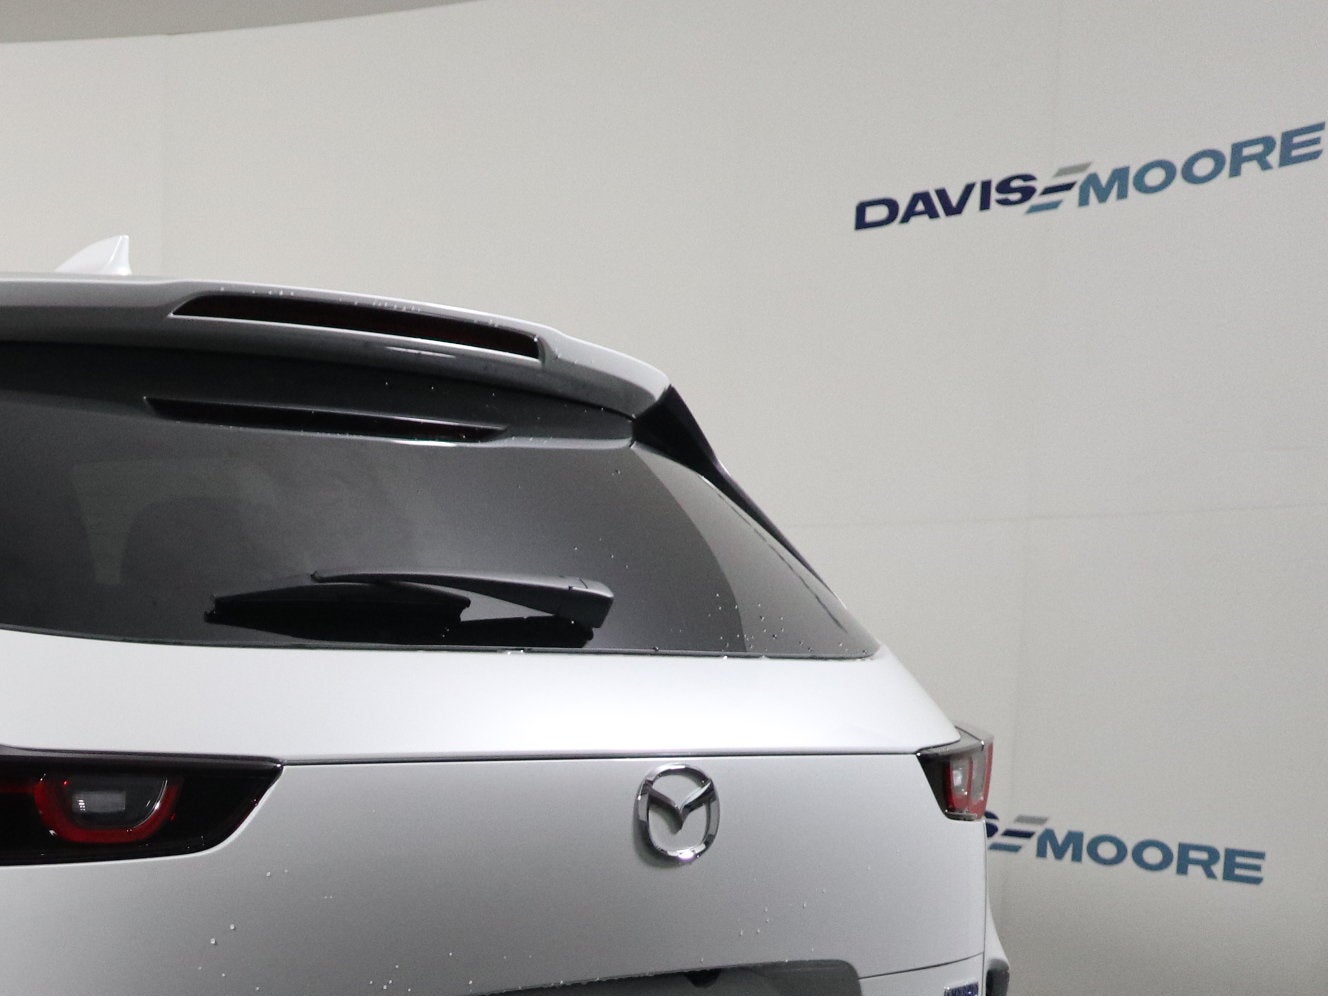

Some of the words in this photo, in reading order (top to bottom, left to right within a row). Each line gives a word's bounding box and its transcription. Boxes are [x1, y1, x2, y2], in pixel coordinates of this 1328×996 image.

[854, 173, 1038, 231] DAVIS
[1078, 121, 1327, 207] MOORE
[1036, 828, 1266, 885] MOORE
